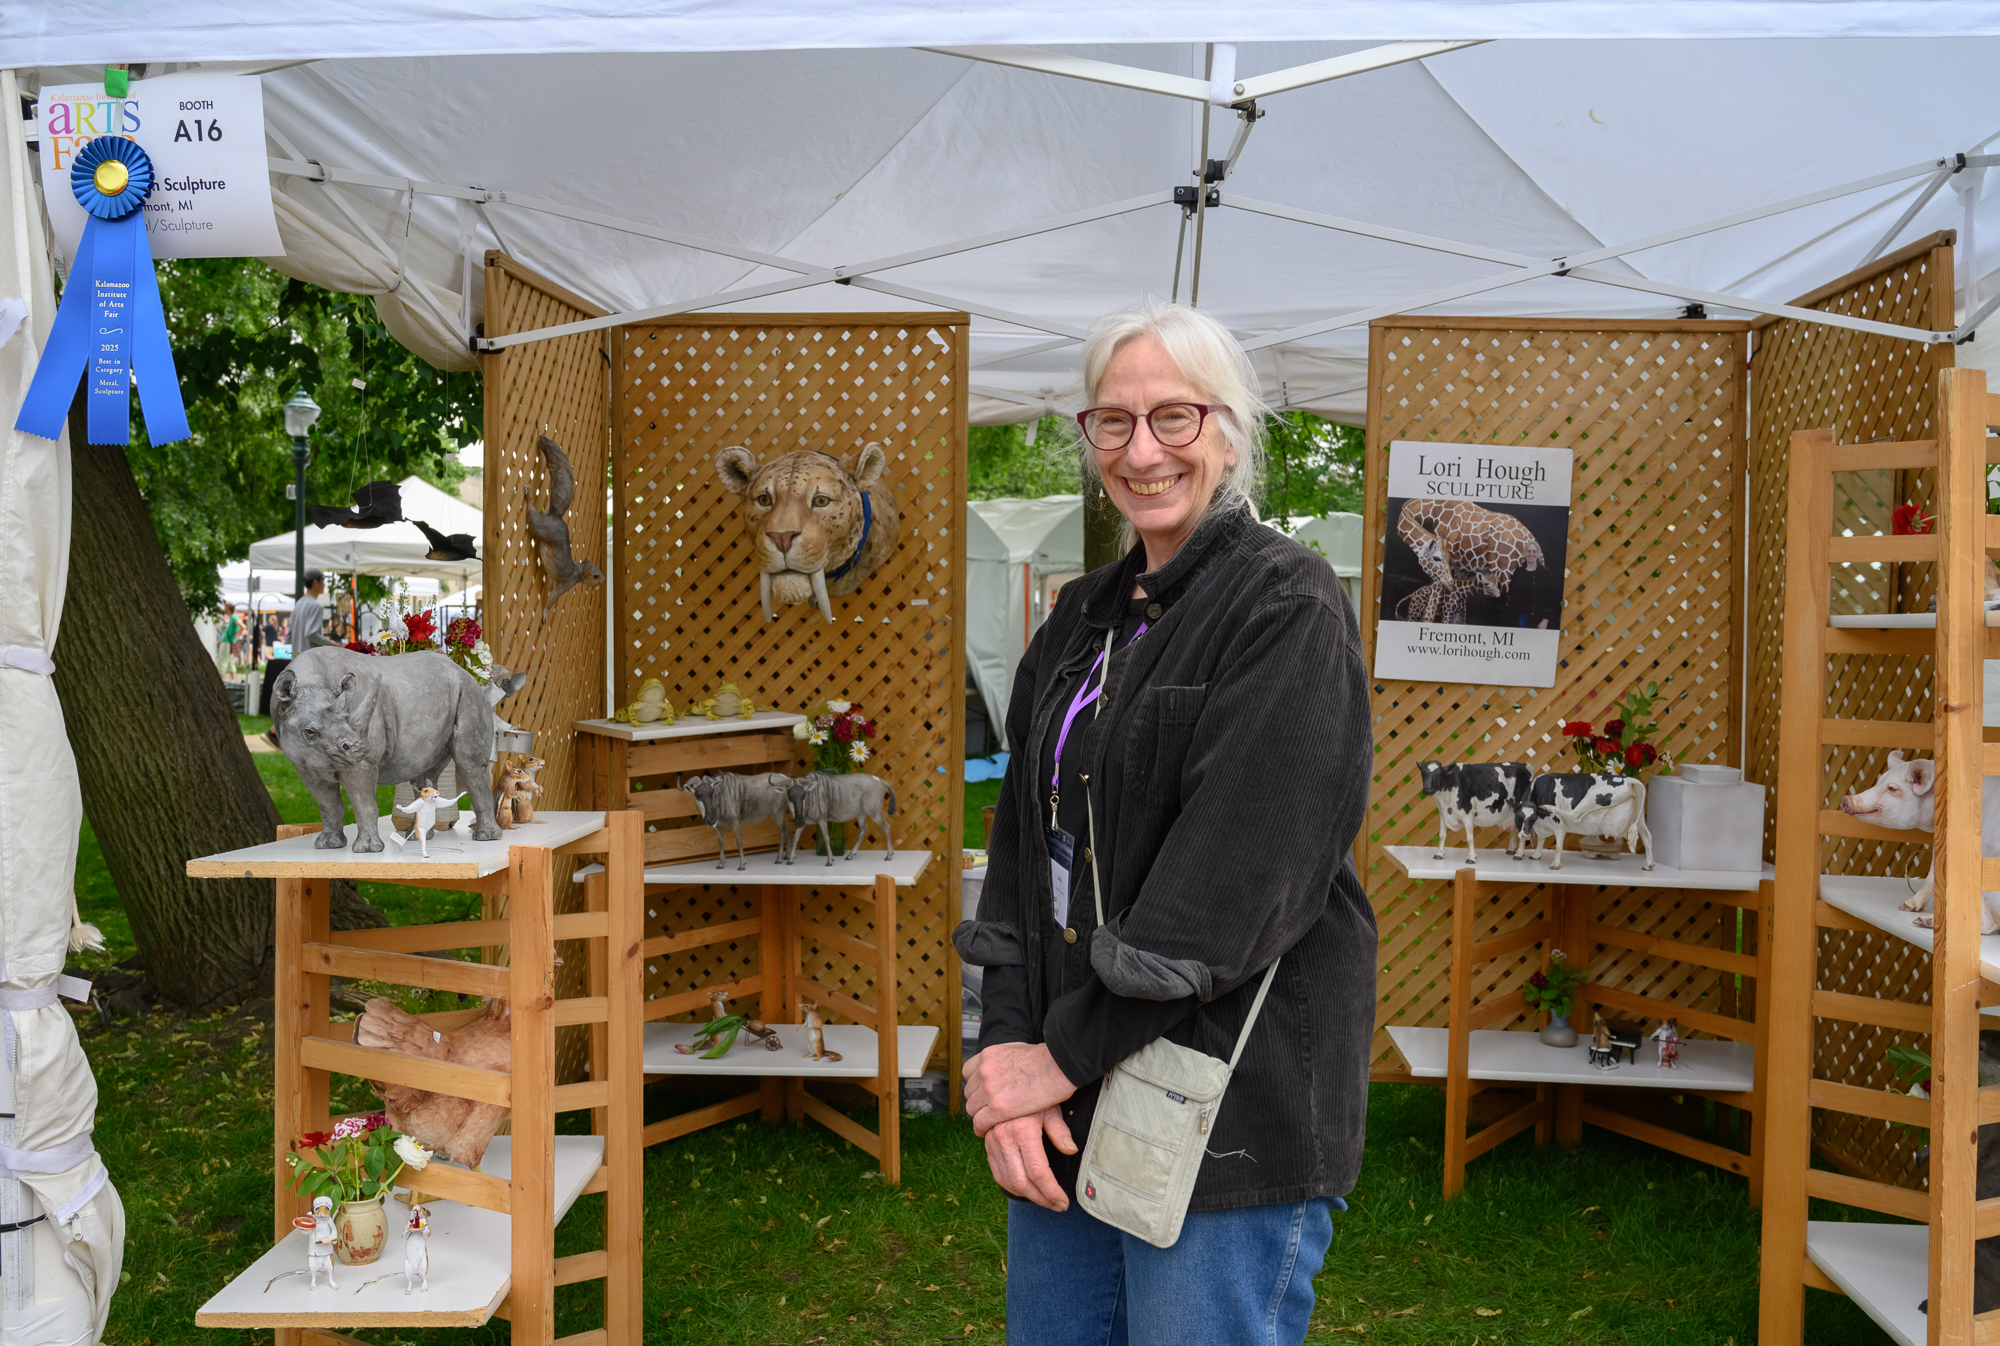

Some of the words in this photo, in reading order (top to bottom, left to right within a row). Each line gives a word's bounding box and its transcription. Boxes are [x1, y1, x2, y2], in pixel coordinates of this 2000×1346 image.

[50, 93, 94, 102] Kalamazoo
[128, 91, 138, 100] of
[179, 100, 214, 111] BOOTH
[173, 118, 223, 143] A16
[164, 175, 226, 195] Sculpture
[141, 201, 174, 213] mont,
[178, 200, 193, 211] MI
[145, 218, 214, 234] l/Sculpture
[95, 280, 130, 288] Kalamazoo
[97, 290, 127, 298] Institute
[99, 300, 106, 308] of
[104, 310, 119, 318] Fair
[100, 344, 119, 352] 2025
[95, 366, 123, 375] Category
[94, 388, 124, 396] Sculpture
[1417, 455, 1462, 478] Lori
[1476, 458, 1546, 486] Hough
[1426, 481, 1535, 500] SCULPTURE
[1418, 627, 1487, 647] Fremont,
[1492, 631, 1515, 646] MI
[1406, 644, 1531, 661] www.lorihough.com
